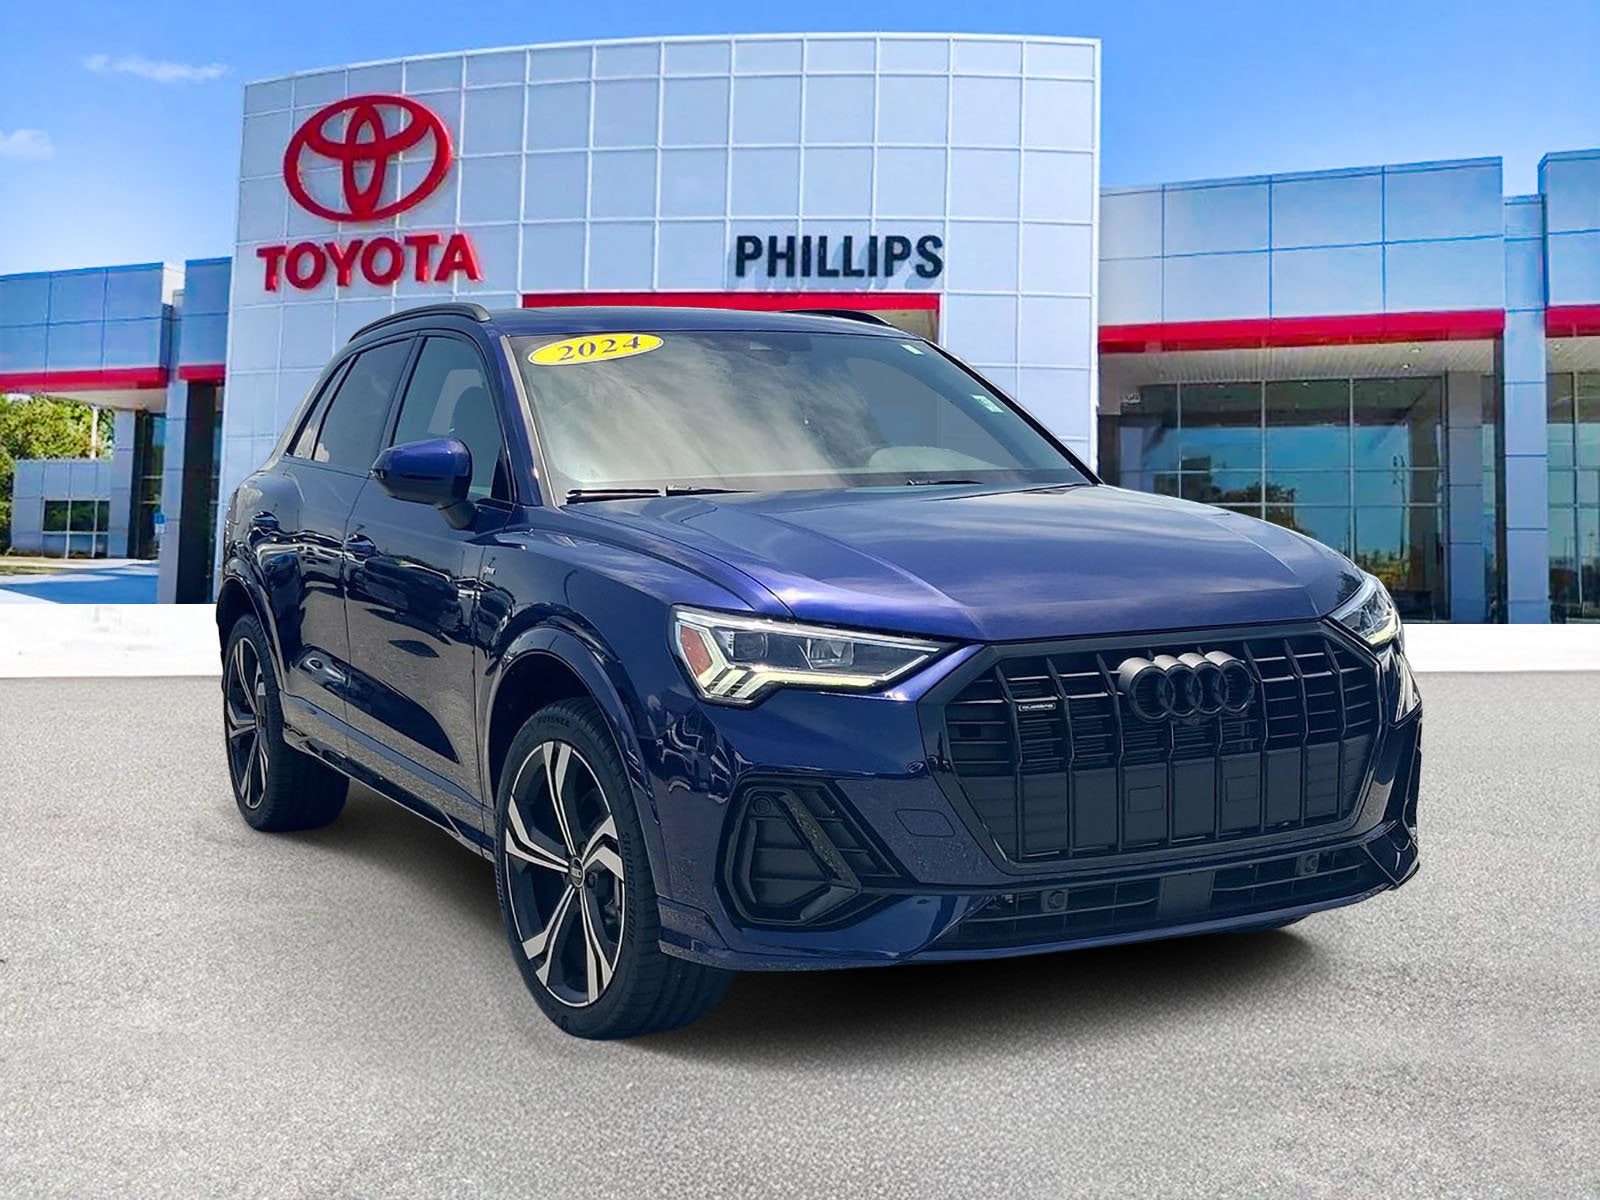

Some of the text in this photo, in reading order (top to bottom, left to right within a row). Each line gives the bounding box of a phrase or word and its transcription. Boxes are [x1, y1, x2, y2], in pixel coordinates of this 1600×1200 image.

[256, 233, 483, 292] TOYOTA
[735, 235, 943, 278] PHILLIPS
[557, 335, 641, 361] 2024
